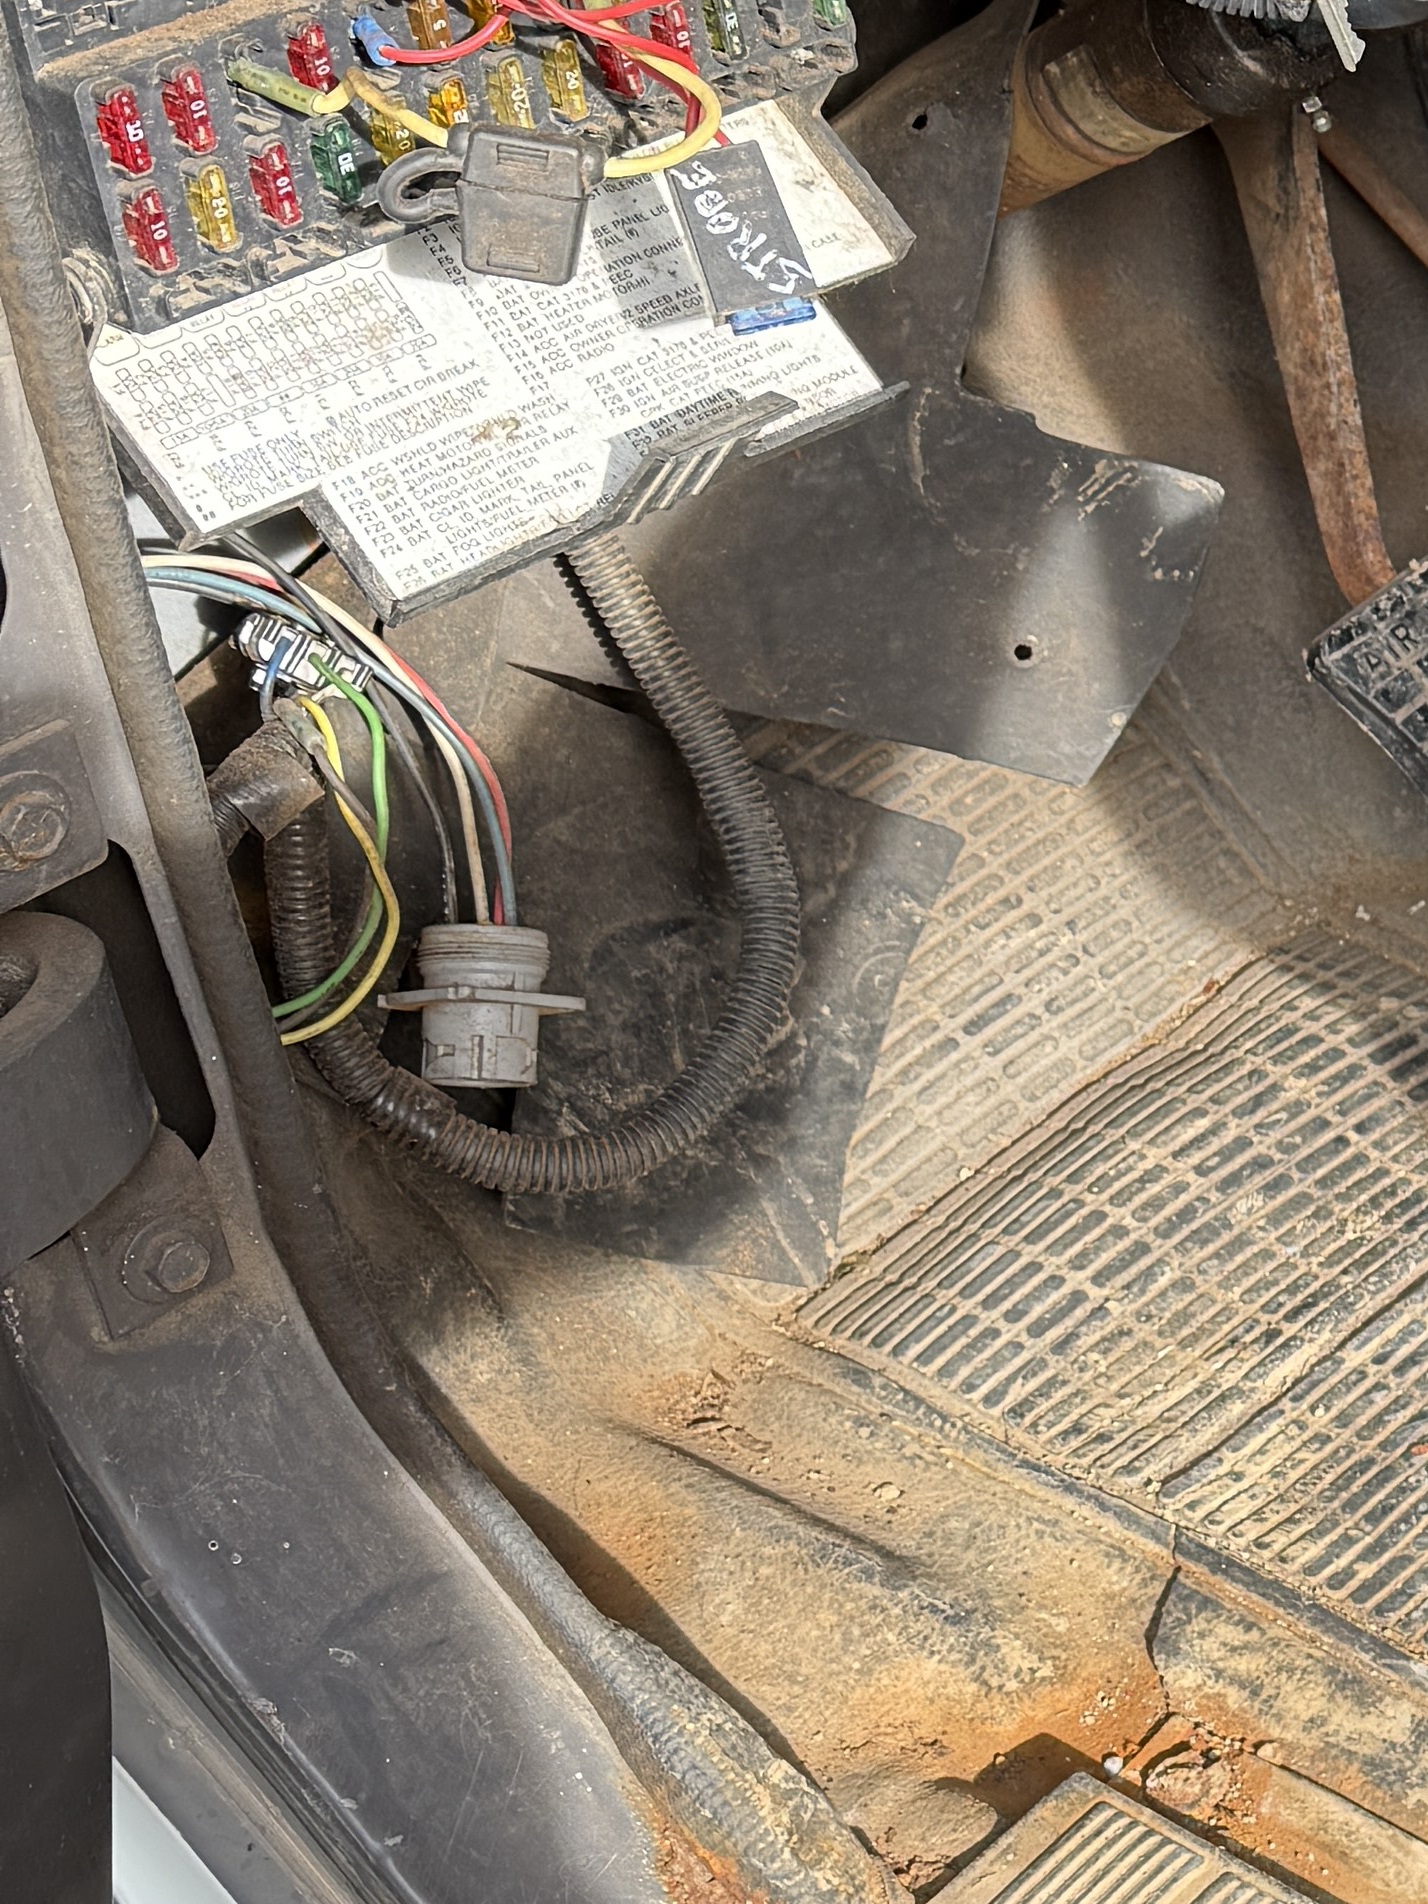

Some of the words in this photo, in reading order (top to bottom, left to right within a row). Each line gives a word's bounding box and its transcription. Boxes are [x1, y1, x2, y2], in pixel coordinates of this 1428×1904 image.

[313, 56, 331, 77] 10
[190, 99, 207, 120] 10
[275, 176, 293, 196] 10
[150, 222, 168, 241] 10
[422, 232, 439, 246] F3
[671, 160, 812, 295] STROBE
[429, 243, 446, 257] F4
[437, 253, 454, 268] F5
[444, 264, 462, 278] F6
[517, 316, 540, 333] BAT
[524, 326, 549, 343] NOT
[551, 312, 584, 332] USED
[562, 327, 583, 342] AIR
[634, 292, 673, 315] SPEED
[569, 328, 616, 353] OWNER
[548, 357, 574, 375] ACC
[577, 341, 615, 363] RADIO
[626, 381, 649, 398] BAT
[652, 358, 709, 387] ELECTRIC
[708, 337, 760, 365] WINDOW
[635, 350, 659, 367] CAT
[713, 349, 764, 378] RELEASE
[337, 400, 374, 422] AUTO
[372, 383, 413, 408] RESET
[413, 373, 437, 391] CIR
[528, 381, 550, 396] F17
[668, 391, 692, 408] CAT
[648, 412, 673, 431] BAT
[674, 390, 727, 419] DAYTIME
[359, 459, 389, 480] ACC
[518, 391, 557, 415] WASH
[389, 402, 475, 445] DESCRIPTION
[383, 495, 408, 514] BAT
[412, 473, 459, 501] CARGO
[551, 423, 578, 442] AUX
[398, 456, 432, 478] HEAT
[375, 485, 400, 502] BAT
[391, 506, 417, 525] BAT
[496, 453, 540, 480] METER
[526, 483, 569, 509] METER
[399, 517, 424, 535] BAT
[469, 473, 526, 505] LIGHTER
[406, 529, 432, 547] BAT
[552, 457, 595, 485] PANEL
[421, 550, 447, 569] BAT
[1364, 622, 1419, 673] AIR
